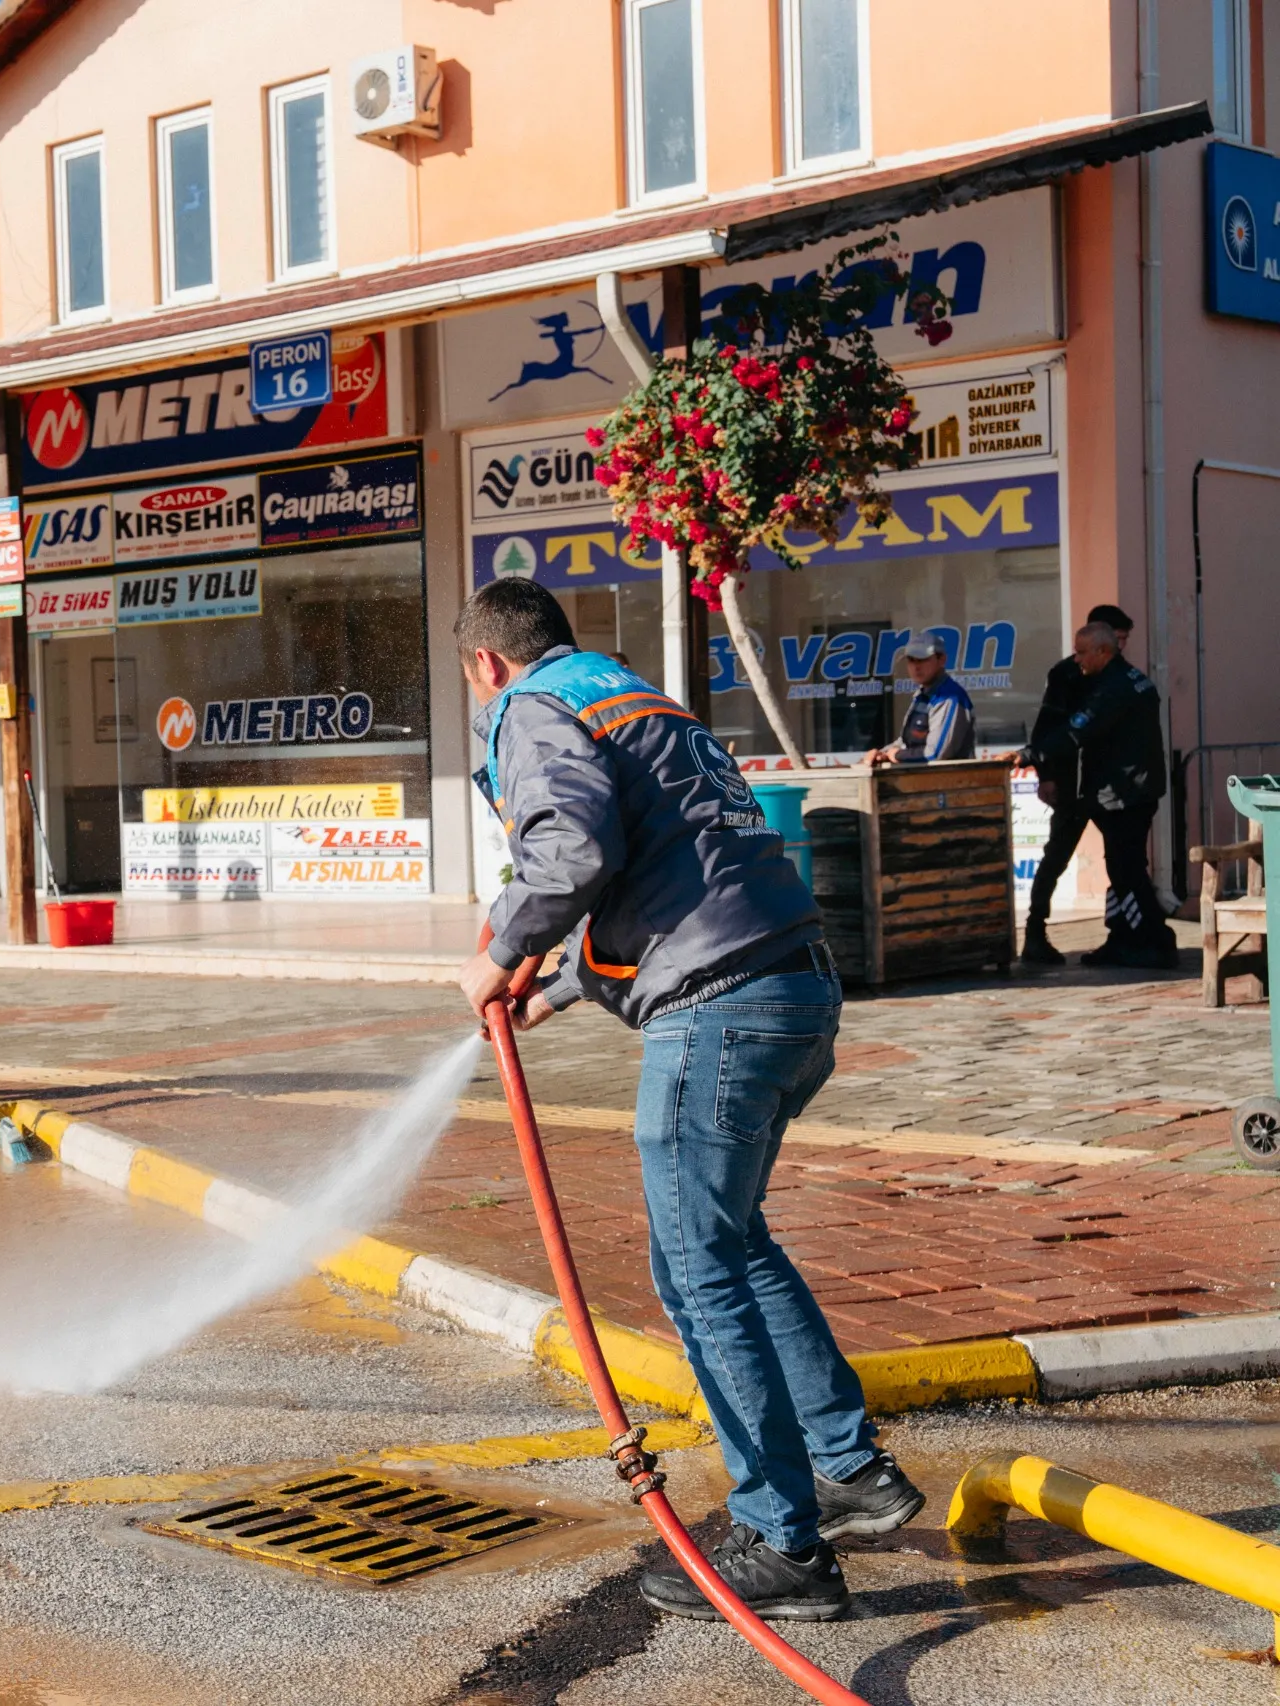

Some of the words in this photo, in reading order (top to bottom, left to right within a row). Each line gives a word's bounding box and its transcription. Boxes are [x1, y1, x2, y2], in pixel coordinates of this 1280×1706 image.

[259, 341, 320, 371] PERON
[272, 367, 308, 400] 16
[968, 381, 1035, 402] GAZİANTEP
[91, 366, 303, 450] METR
[968, 399, 1036, 422] ŞANLIURFA
[968, 419, 1020, 438] SİVEREK
[969, 434, 1043, 455] DİYARBAKIR
[119, 576, 179, 608] MUŞ
[187, 568, 258, 602] YOLU
[38, 591, 58, 615] ÖZ
[201, 691, 374, 745] METRO
[291, 793, 366, 818] Kalesi
[722, 810, 754, 828] TEMİZLİK
[321, 827, 410, 848] ZAFER
